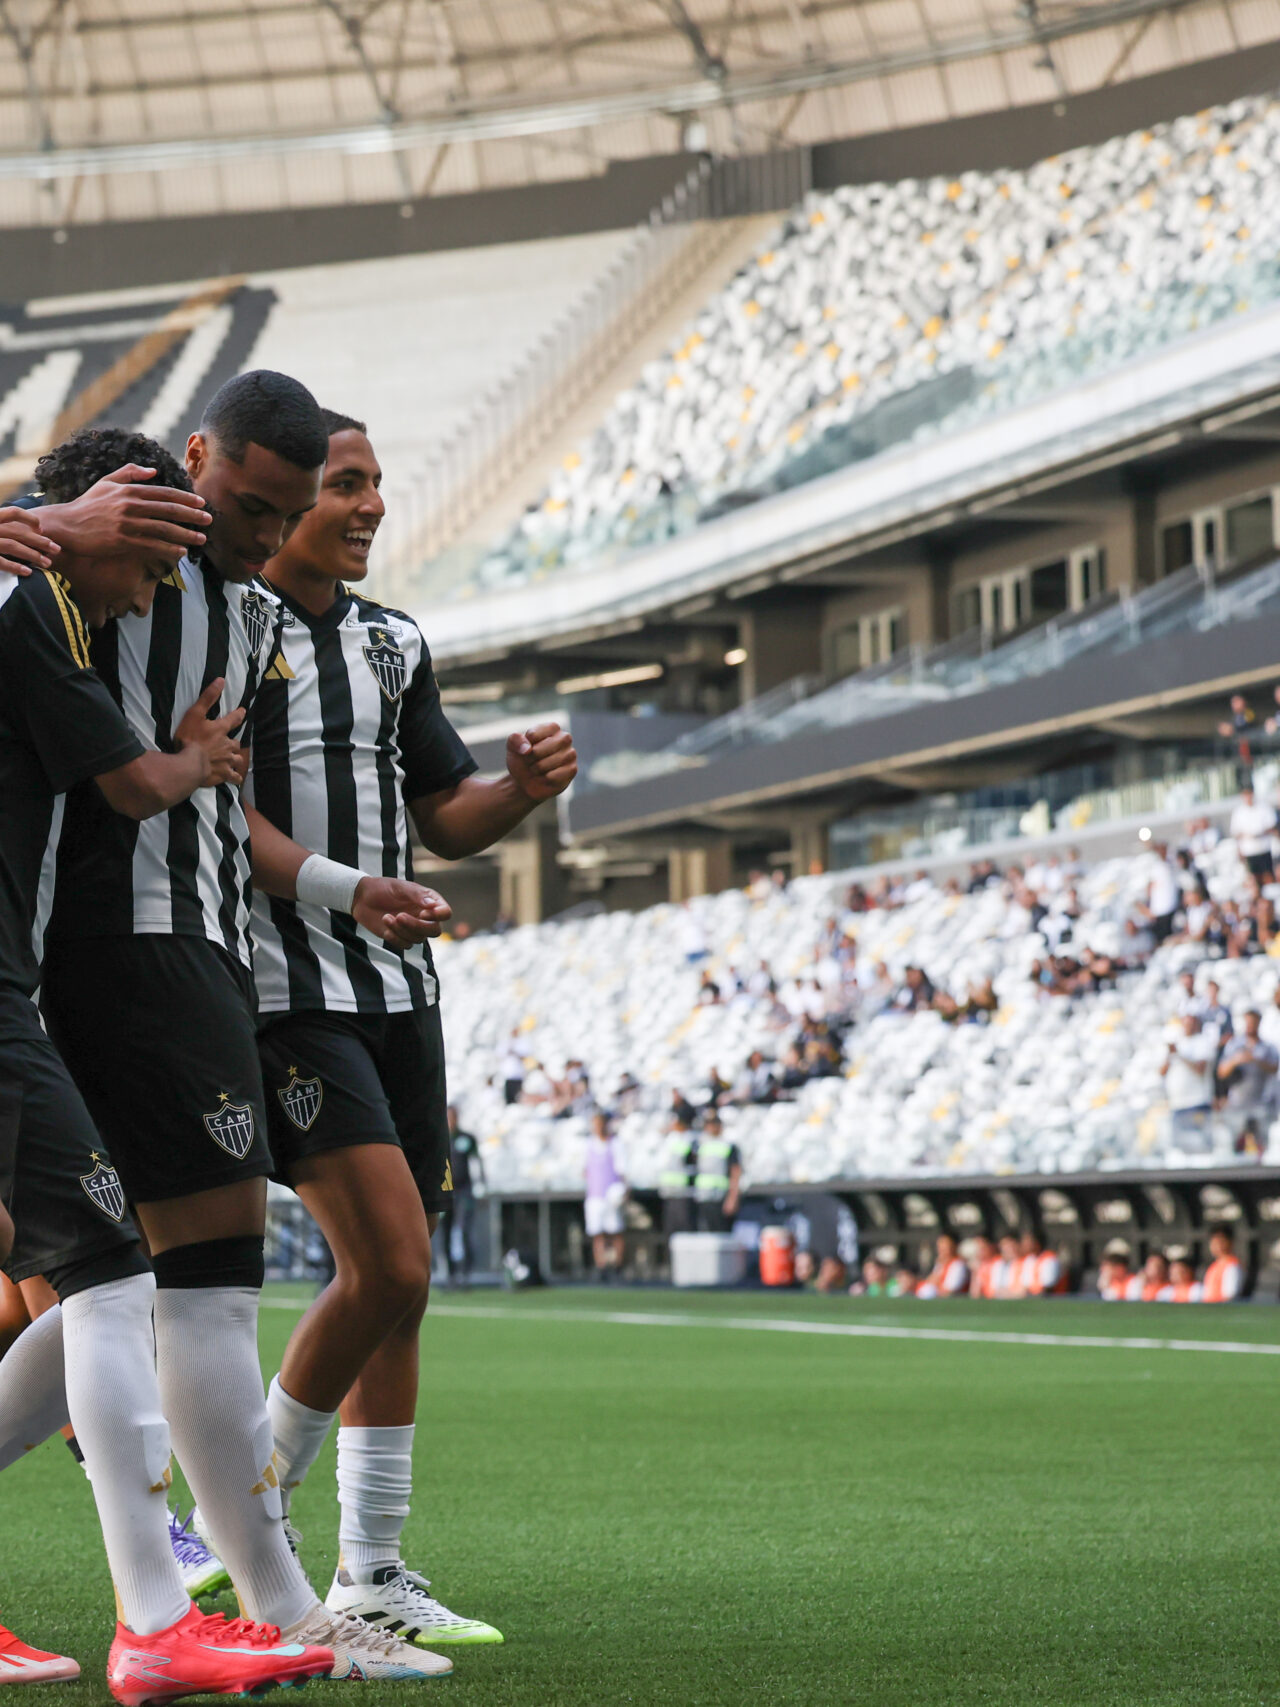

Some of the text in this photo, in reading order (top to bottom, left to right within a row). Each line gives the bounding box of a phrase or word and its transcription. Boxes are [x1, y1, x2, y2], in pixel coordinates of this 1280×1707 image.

[245, 603, 266, 624] CAM
[371, 652, 402, 666] CAM
[286, 1085, 315, 1101] CAM
[214, 1113, 247, 1127] CAM
[90, 1174, 116, 1188] CAM
